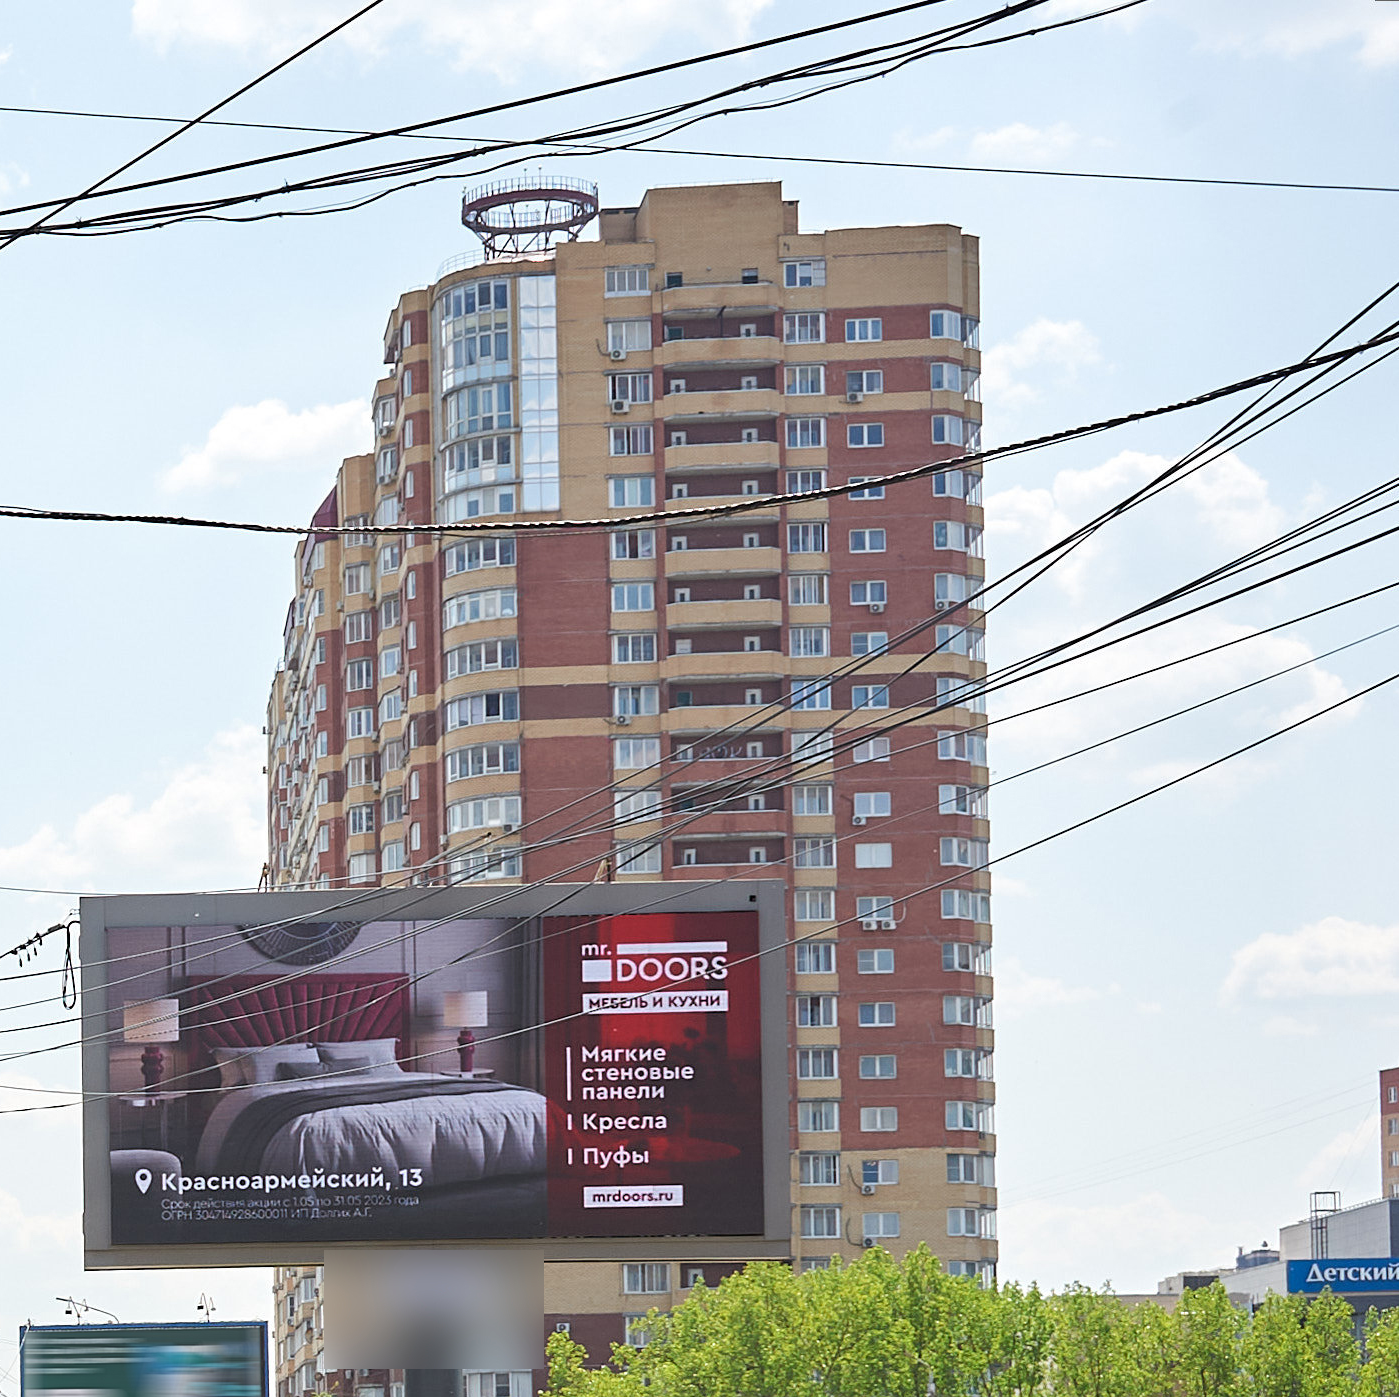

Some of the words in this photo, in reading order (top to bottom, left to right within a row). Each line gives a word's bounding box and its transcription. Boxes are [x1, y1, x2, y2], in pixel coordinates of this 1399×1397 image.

[581, 944, 612, 957] mr.
[616, 956, 728, 982] DOORS
[588, 997, 648, 1009] МЕБЕЛЬ
[652, 996, 663, 1008] И
[668, 995, 721, 1008] КУХНИ
[581, 1046, 667, 1063] Мягкие
[581, 1065, 695, 1081] стеновые
[582, 1085, 665, 1100] панели
[582, 1113, 668, 1134] Кресла
[583, 1145, 650, 1169] Пуфы
[161, 1166, 392, 1195] Красноармейский,
[398, 1168, 424, 1188] 13
[161, 1199, 192, 1210] Срок
[192, 1197, 245, 1210] действия
[247, 1198, 281, 1209] акции
[393, 1196, 420, 1207] года
[592, 1190, 674, 1203] mrdoors.ru
[161, 1210, 193, 1221] ОГРН
[1306, 1262, 1399, 1283] Детский
